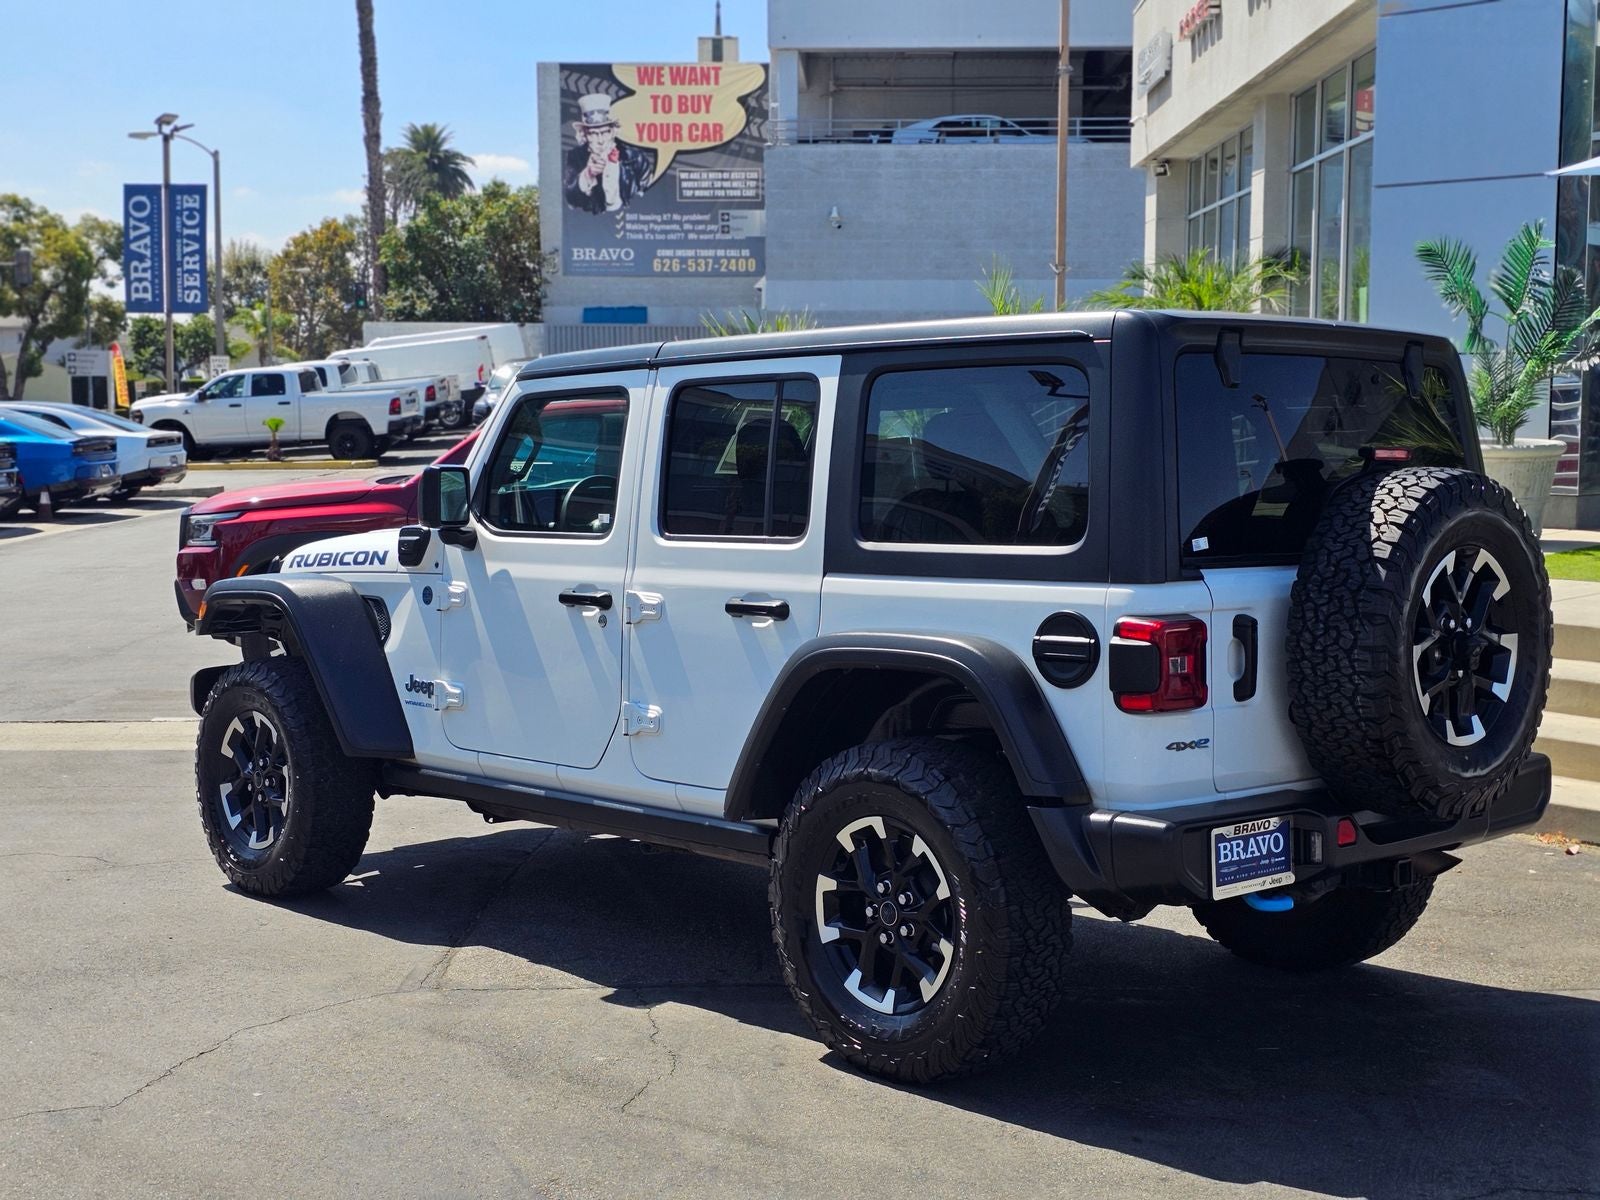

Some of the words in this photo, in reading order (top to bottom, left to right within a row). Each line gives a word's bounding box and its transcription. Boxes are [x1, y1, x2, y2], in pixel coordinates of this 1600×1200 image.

[636, 65, 665, 86] WE
[669, 65, 722, 86] WANT
[650, 94, 673, 114] TO
[677, 94, 713, 114] BUY
[635, 122, 683, 143] YOUR
[688, 122, 724, 143] CAR
[626, 223, 648, 232] Making
[128, 194, 153, 303] BRAVO
[182, 194, 201, 304] SERVICE
[571, 248, 635, 261] BRAVO
[726, 249, 740, 257] CALL
[741, 249, 750, 257] US
[653, 258, 756, 272] 626-537-2400
[288, 550, 390, 568] RUBICON
[405, 674, 434, 699] Jeep
[1233, 819, 1271, 836] BRAVO
[1217, 832, 1284, 864] BRAVO
